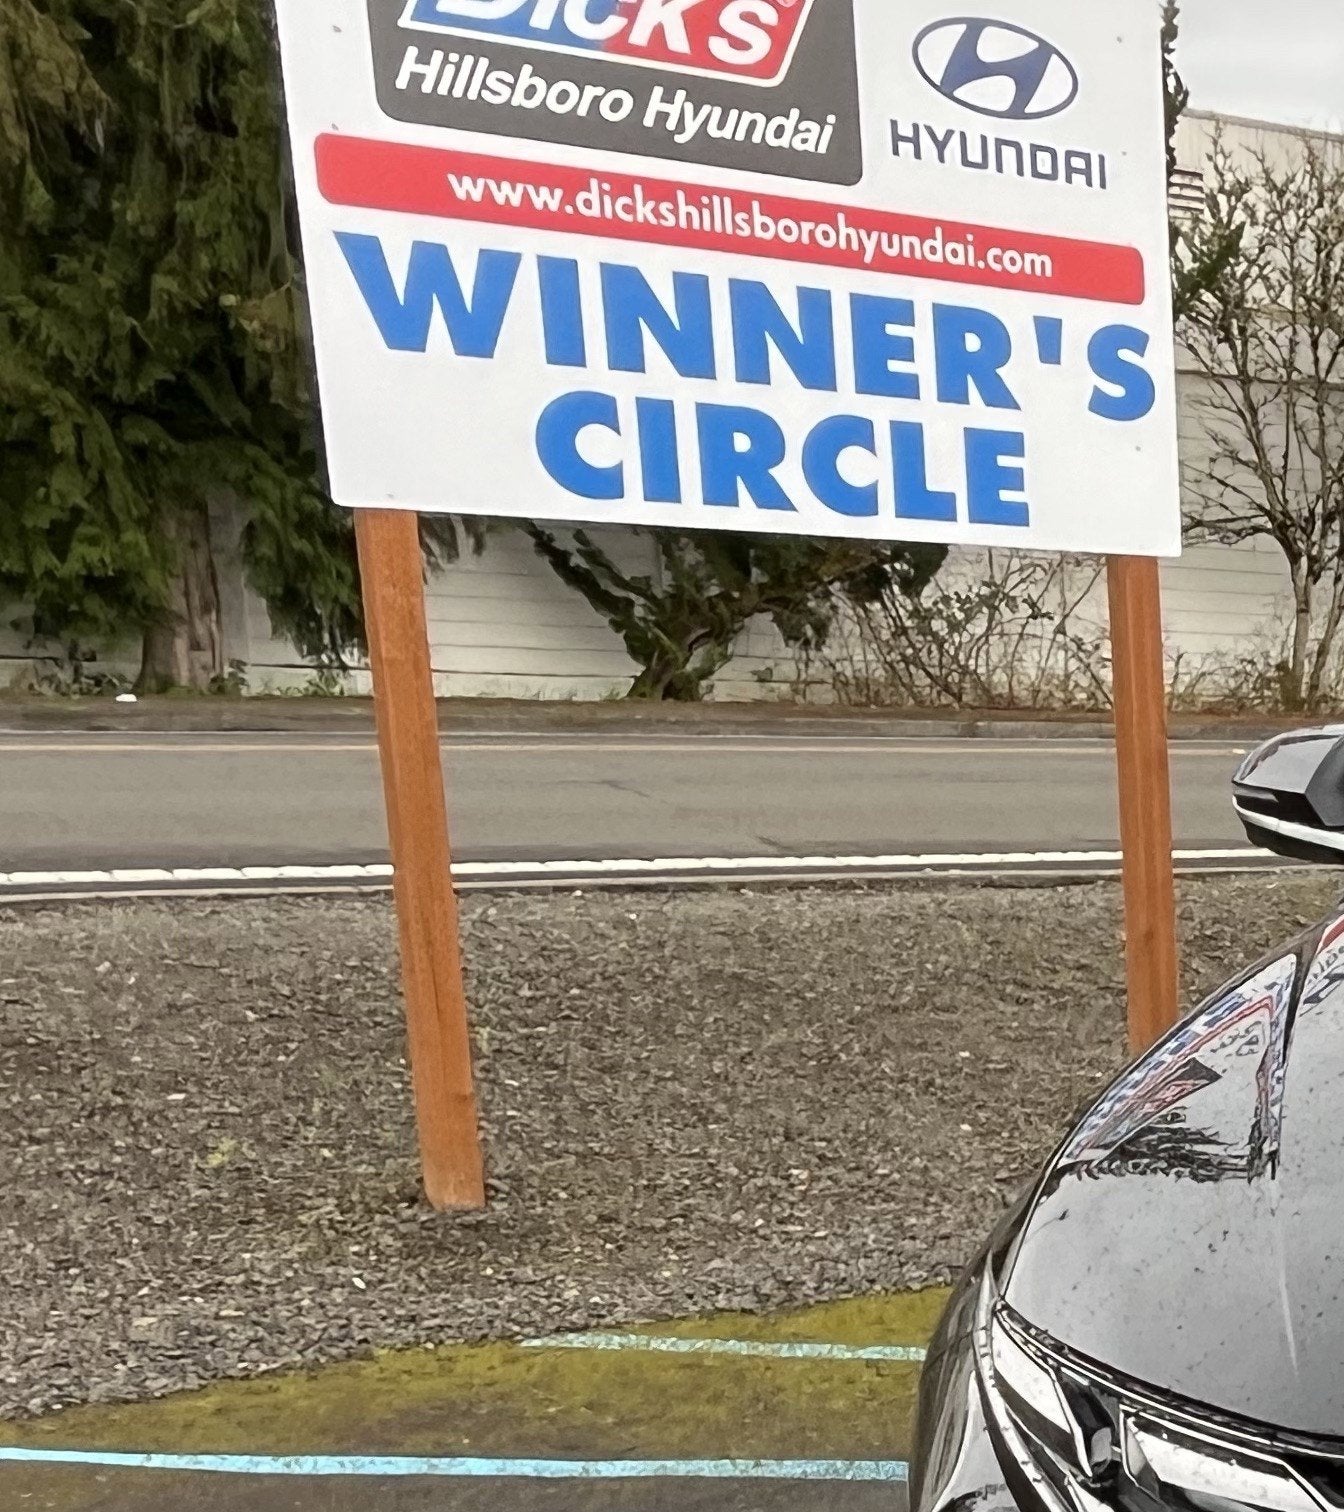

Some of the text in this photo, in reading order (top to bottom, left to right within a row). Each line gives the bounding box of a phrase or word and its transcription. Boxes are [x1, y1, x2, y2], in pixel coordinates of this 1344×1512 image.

[396, 46, 836, 154] Hillsboro Hyundai
[890, 118, 1107, 190] HYUNDAI
[447, 170, 1053, 279] www.dickshillsborohyundai.com
[333, 231, 1156, 422] WINNER'S
[535, 391, 1031, 528] CIRCLE
